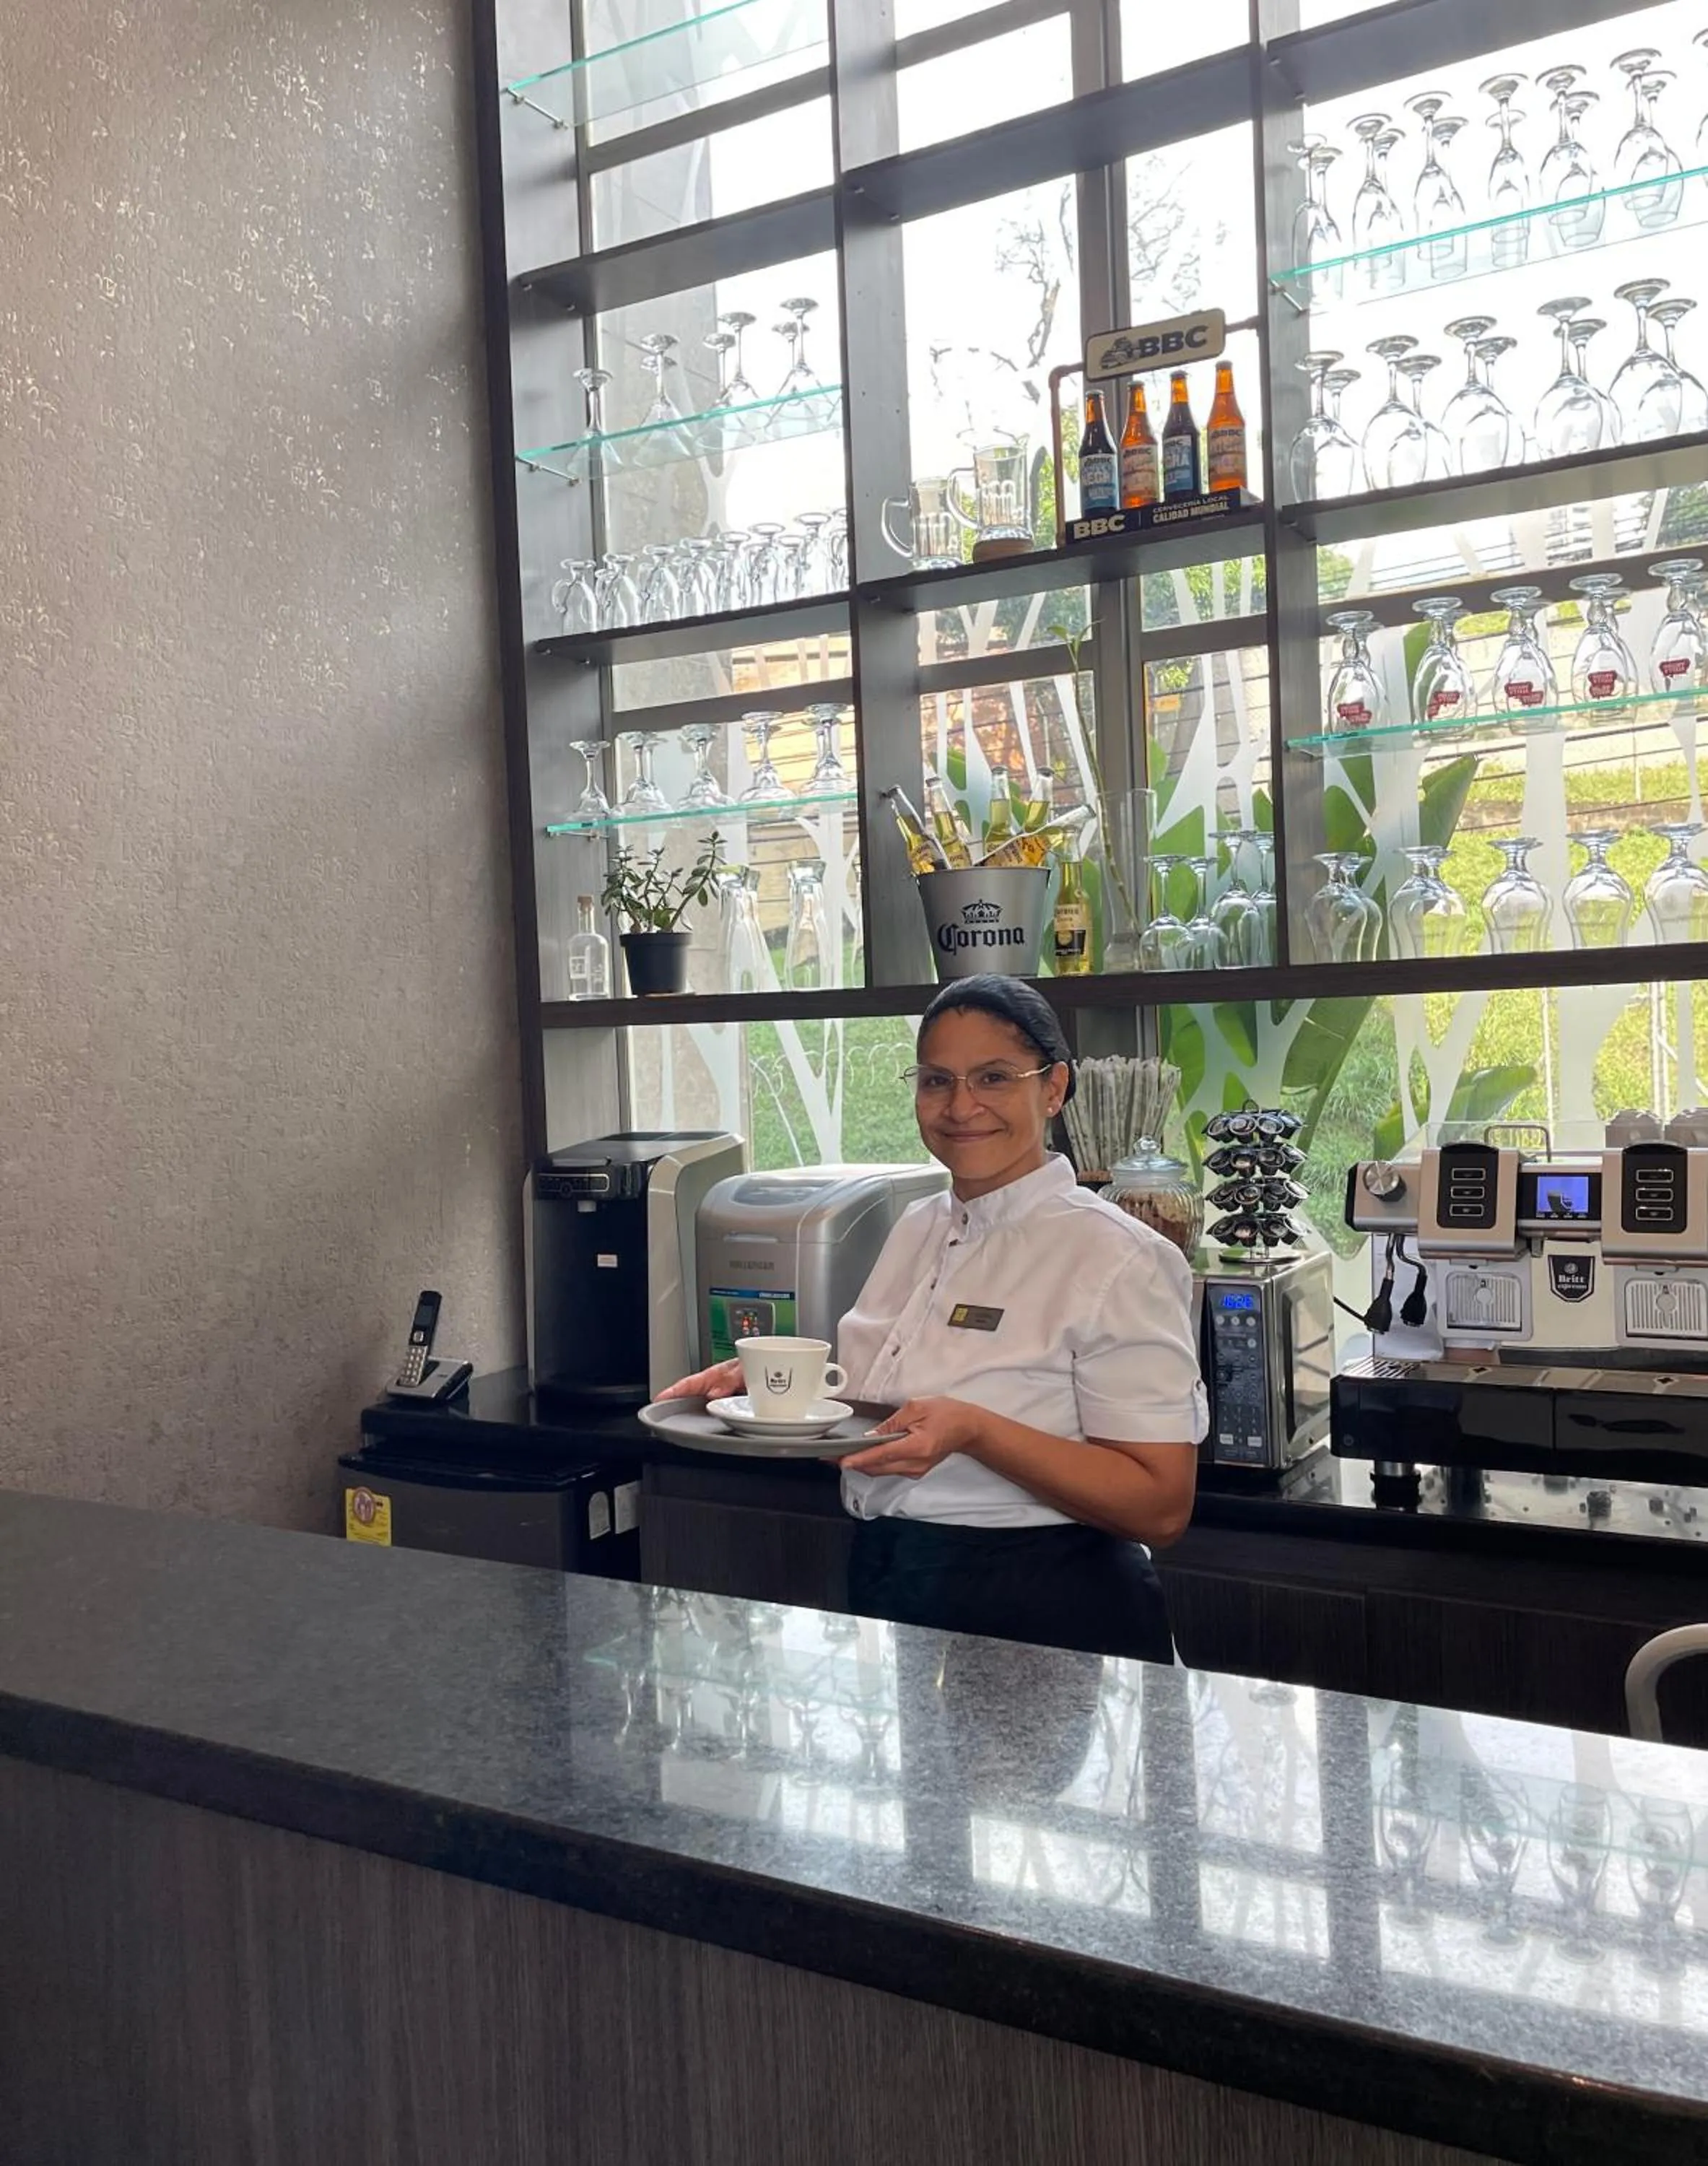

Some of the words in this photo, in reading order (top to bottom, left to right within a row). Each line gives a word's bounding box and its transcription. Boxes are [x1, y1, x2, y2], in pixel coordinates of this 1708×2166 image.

[1139, 326, 1211, 358] BBC
[1073, 513, 1126, 540] BBC
[1152, 508, 1190, 523] CALIDAD
[938, 923, 1026, 955] Corona
[1559, 1274, 1585, 1283] Britt
